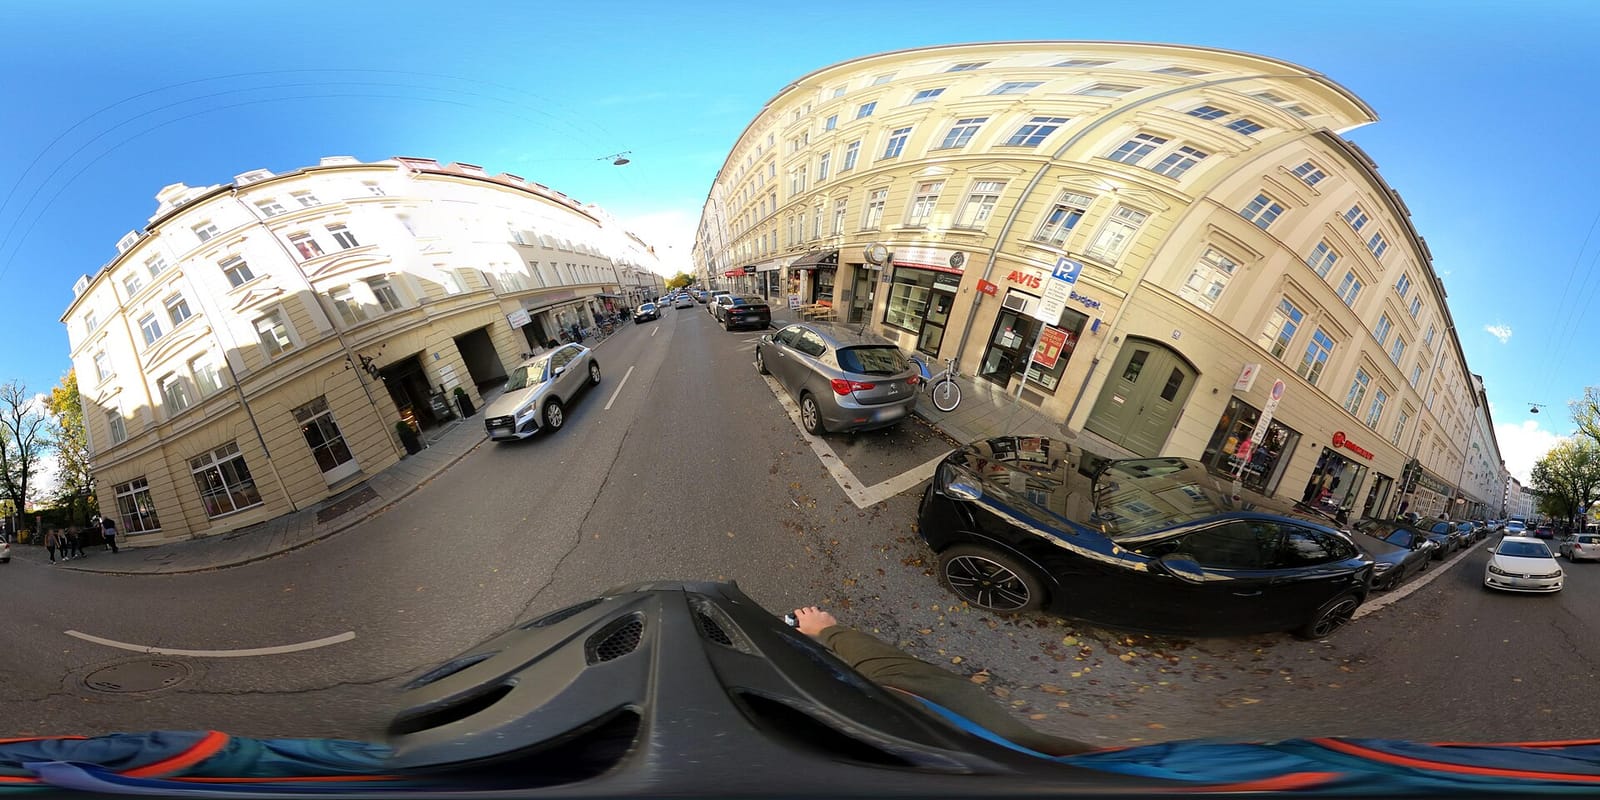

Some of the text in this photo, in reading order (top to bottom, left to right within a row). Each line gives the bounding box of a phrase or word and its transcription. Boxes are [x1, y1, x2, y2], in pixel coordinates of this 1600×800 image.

[1055, 260, 1074, 276] P
[1007, 270, 1040, 288] AVIS
[1070, 291, 1100, 309] Budget
